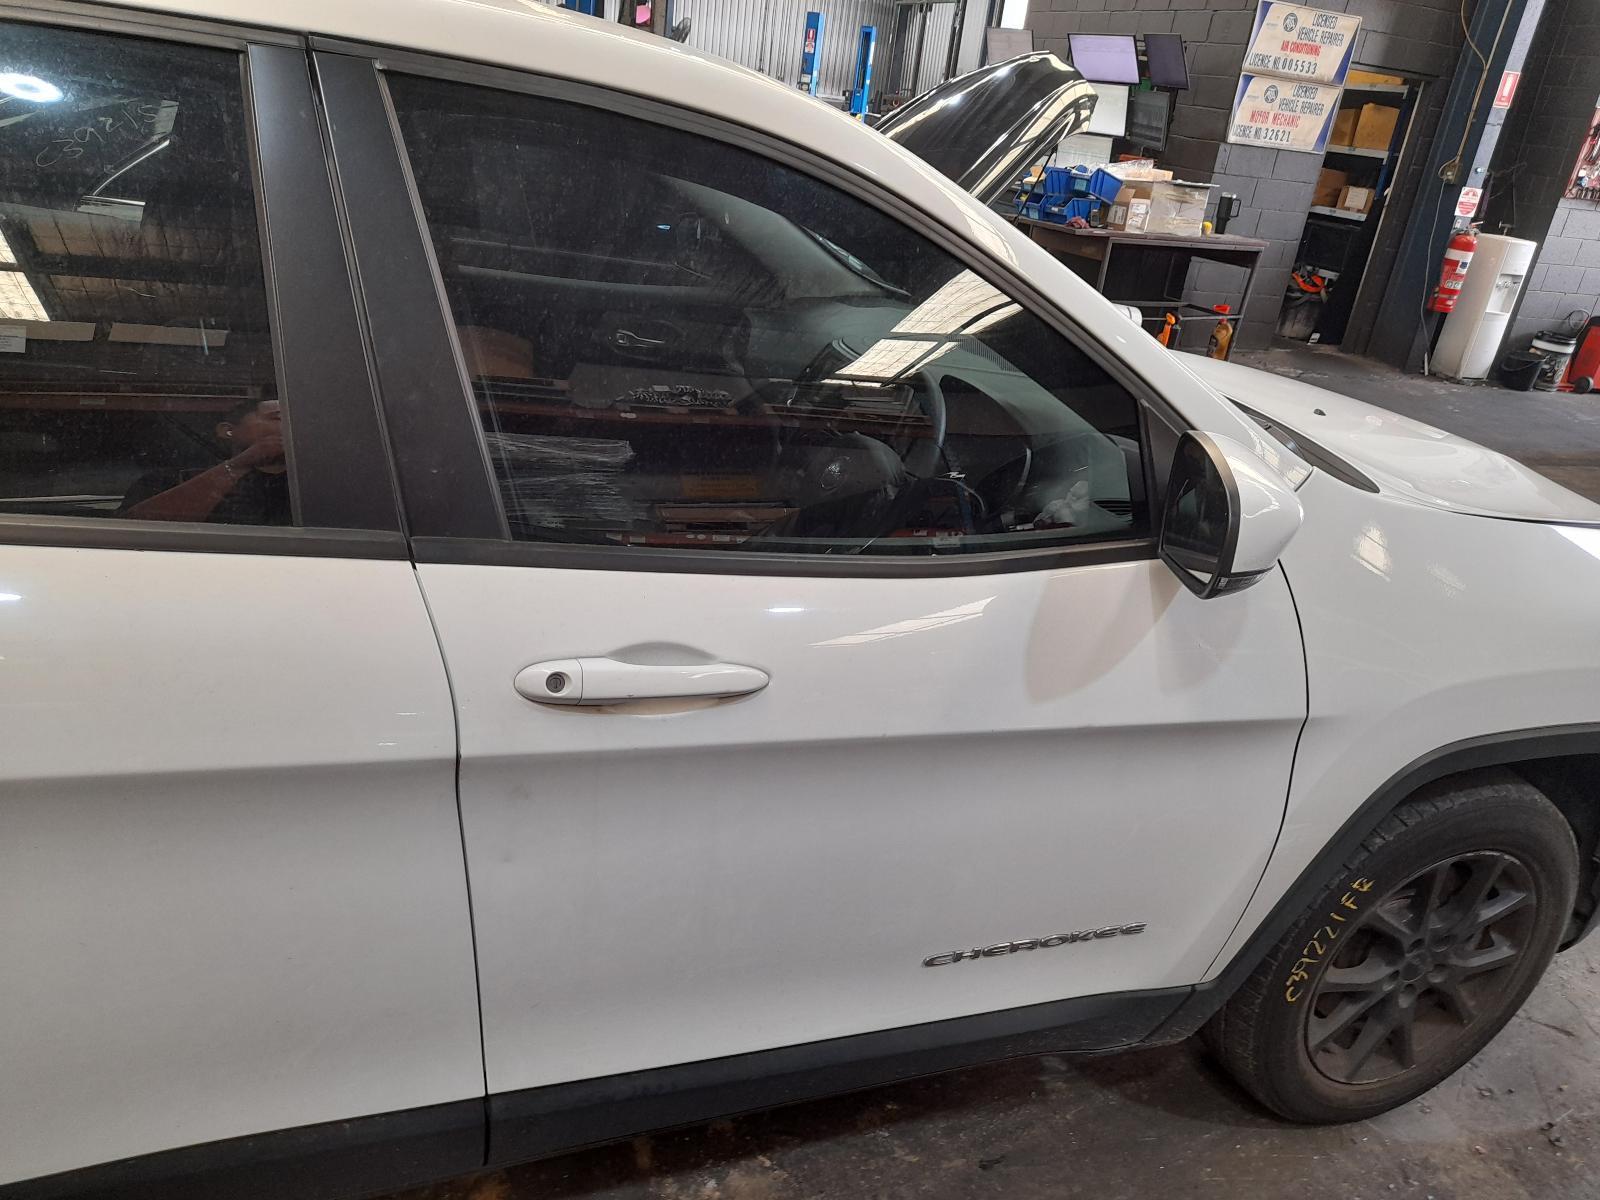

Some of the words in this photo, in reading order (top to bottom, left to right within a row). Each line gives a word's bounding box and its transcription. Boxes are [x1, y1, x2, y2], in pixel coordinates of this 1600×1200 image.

[1312, 12, 1338, 29] LICENSED
[1297, 27, 1319, 42] VEHICLE
[1320, 30, 1344, 47] REPAIRER
[1280, 40, 1290, 52] AIR
[1290, 41, 1321, 56] CONDITIONING
[1292, 84, 1318, 100] LICENSED
[1279, 98, 1299, 113] VEHICLE
[1300, 101, 1324, 116] REPAIRER
[1249, 110, 1270, 125] MOTOR
[1271, 113, 1300, 128] MECHANIC
[1263, 128, 1291, 142] 32621
[922, 922, 1147, 967] CHEROKEE
